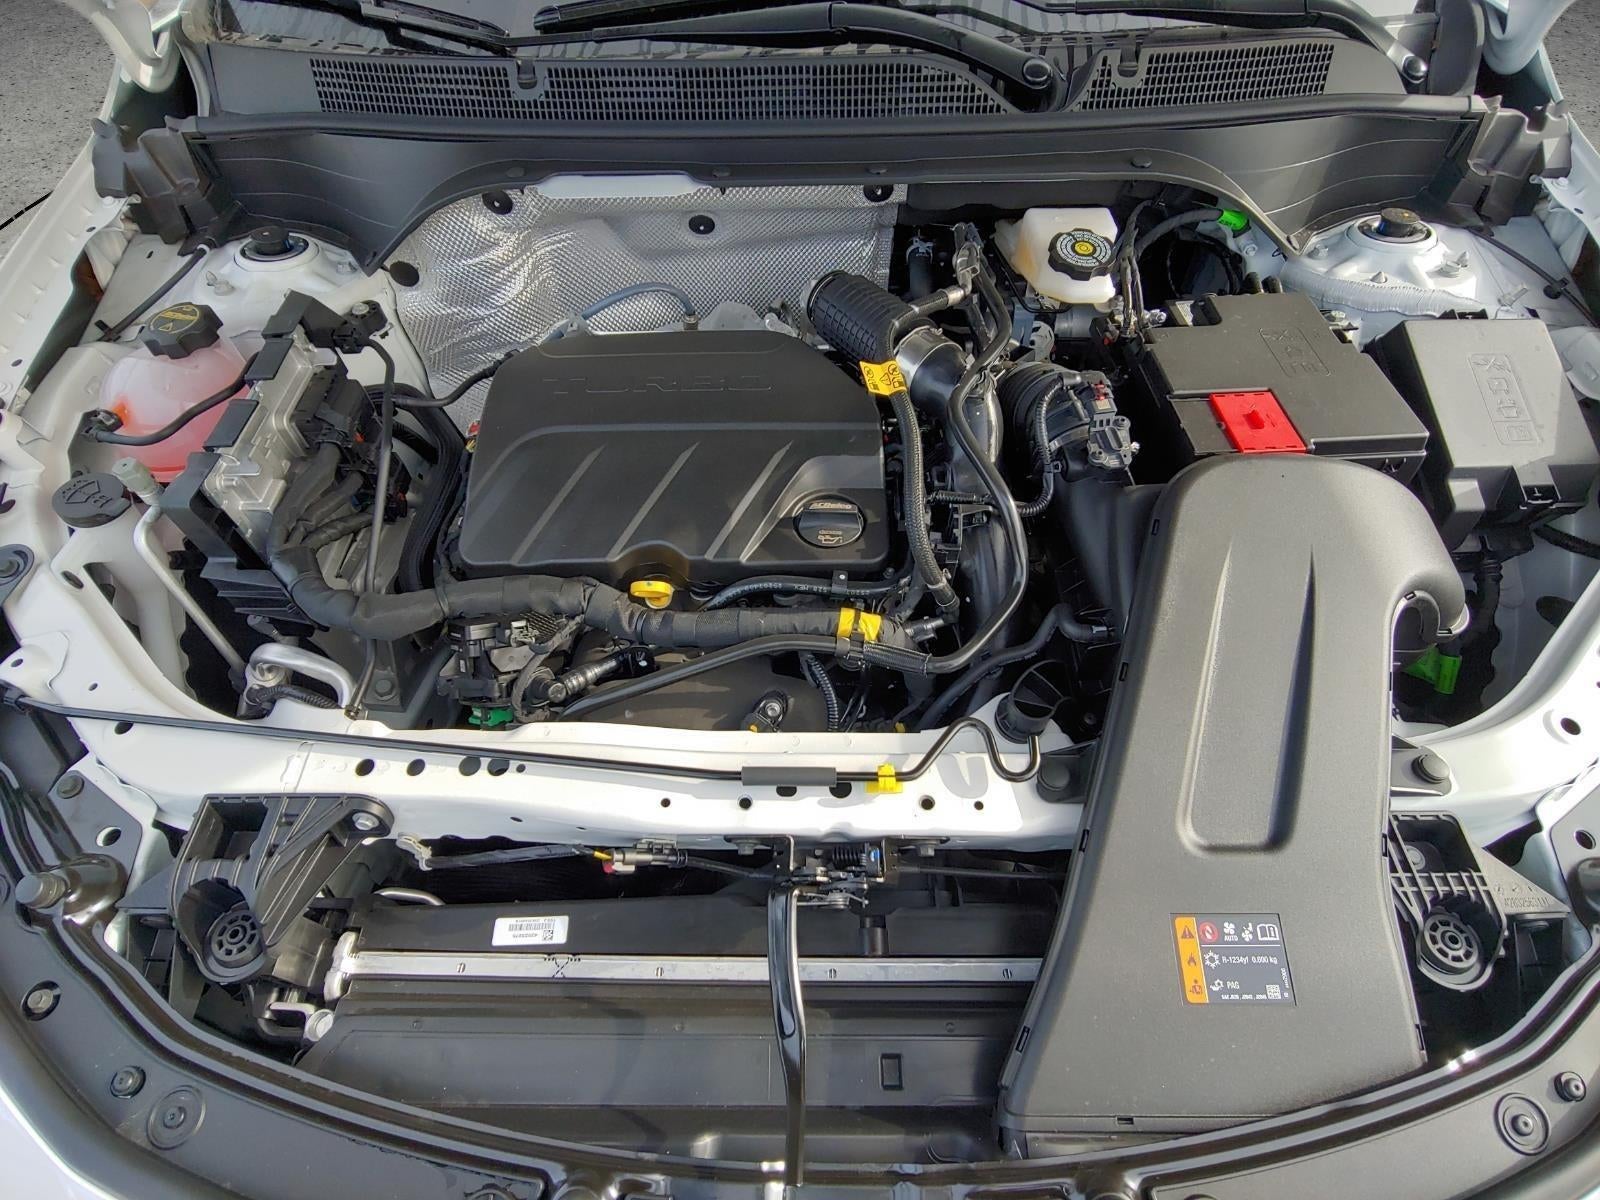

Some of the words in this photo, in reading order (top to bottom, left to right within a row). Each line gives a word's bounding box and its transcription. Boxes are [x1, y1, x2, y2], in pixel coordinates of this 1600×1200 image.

[541, 375, 776, 394] TURBO
[1269, 955, 1278, 965] kg
[1226, 981, 1240, 990] PAG
